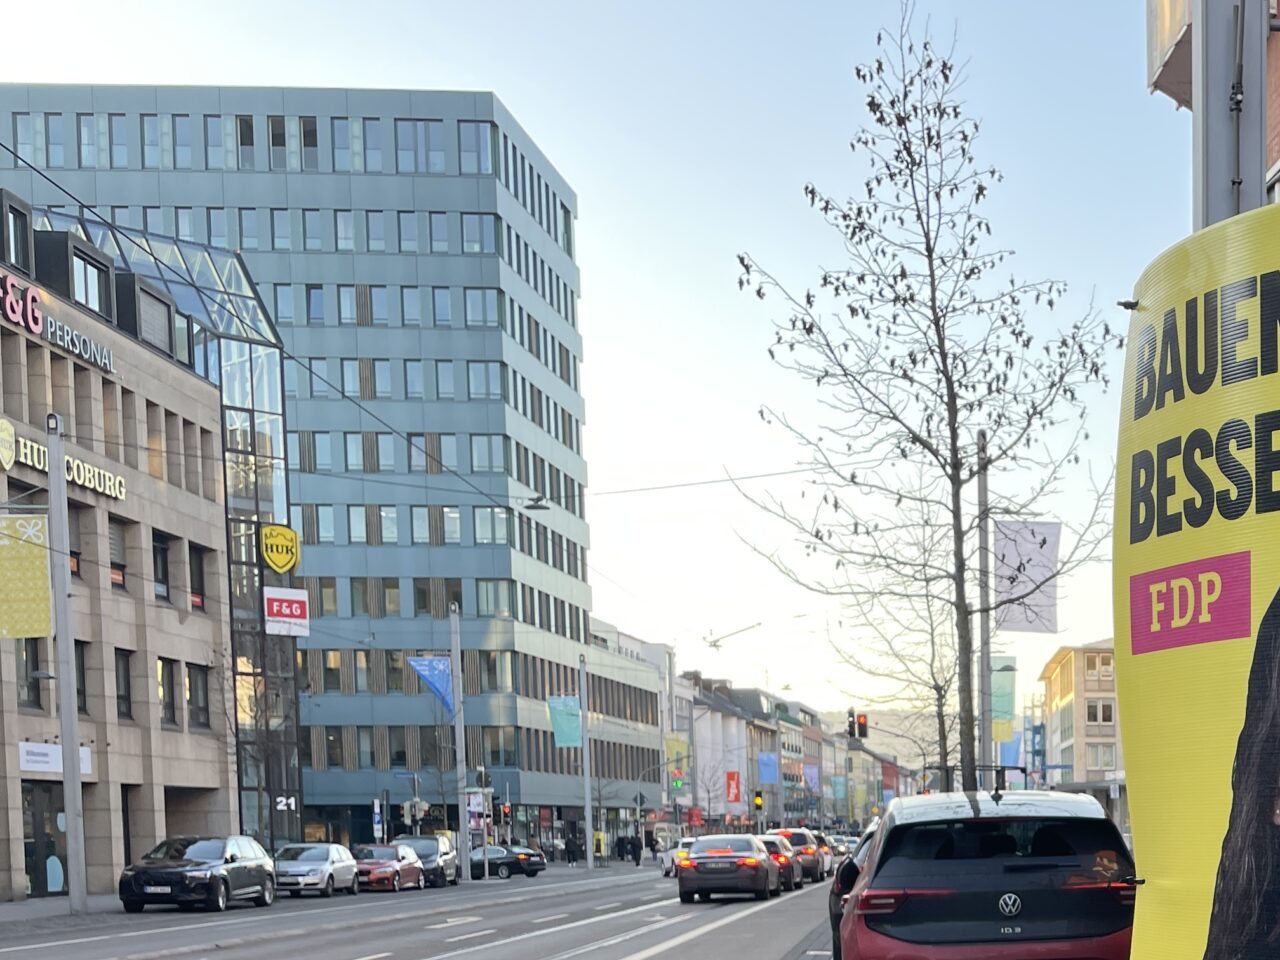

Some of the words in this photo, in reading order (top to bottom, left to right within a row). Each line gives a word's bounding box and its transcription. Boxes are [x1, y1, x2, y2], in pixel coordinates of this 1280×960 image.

[46, 315, 118, 373] PERSONAL
[64, 454, 126, 501] COBURG
[264, 543, 295, 556] HUK
[1148, 570, 1222, 634] FDP
[276, 796, 296, 811] 21
